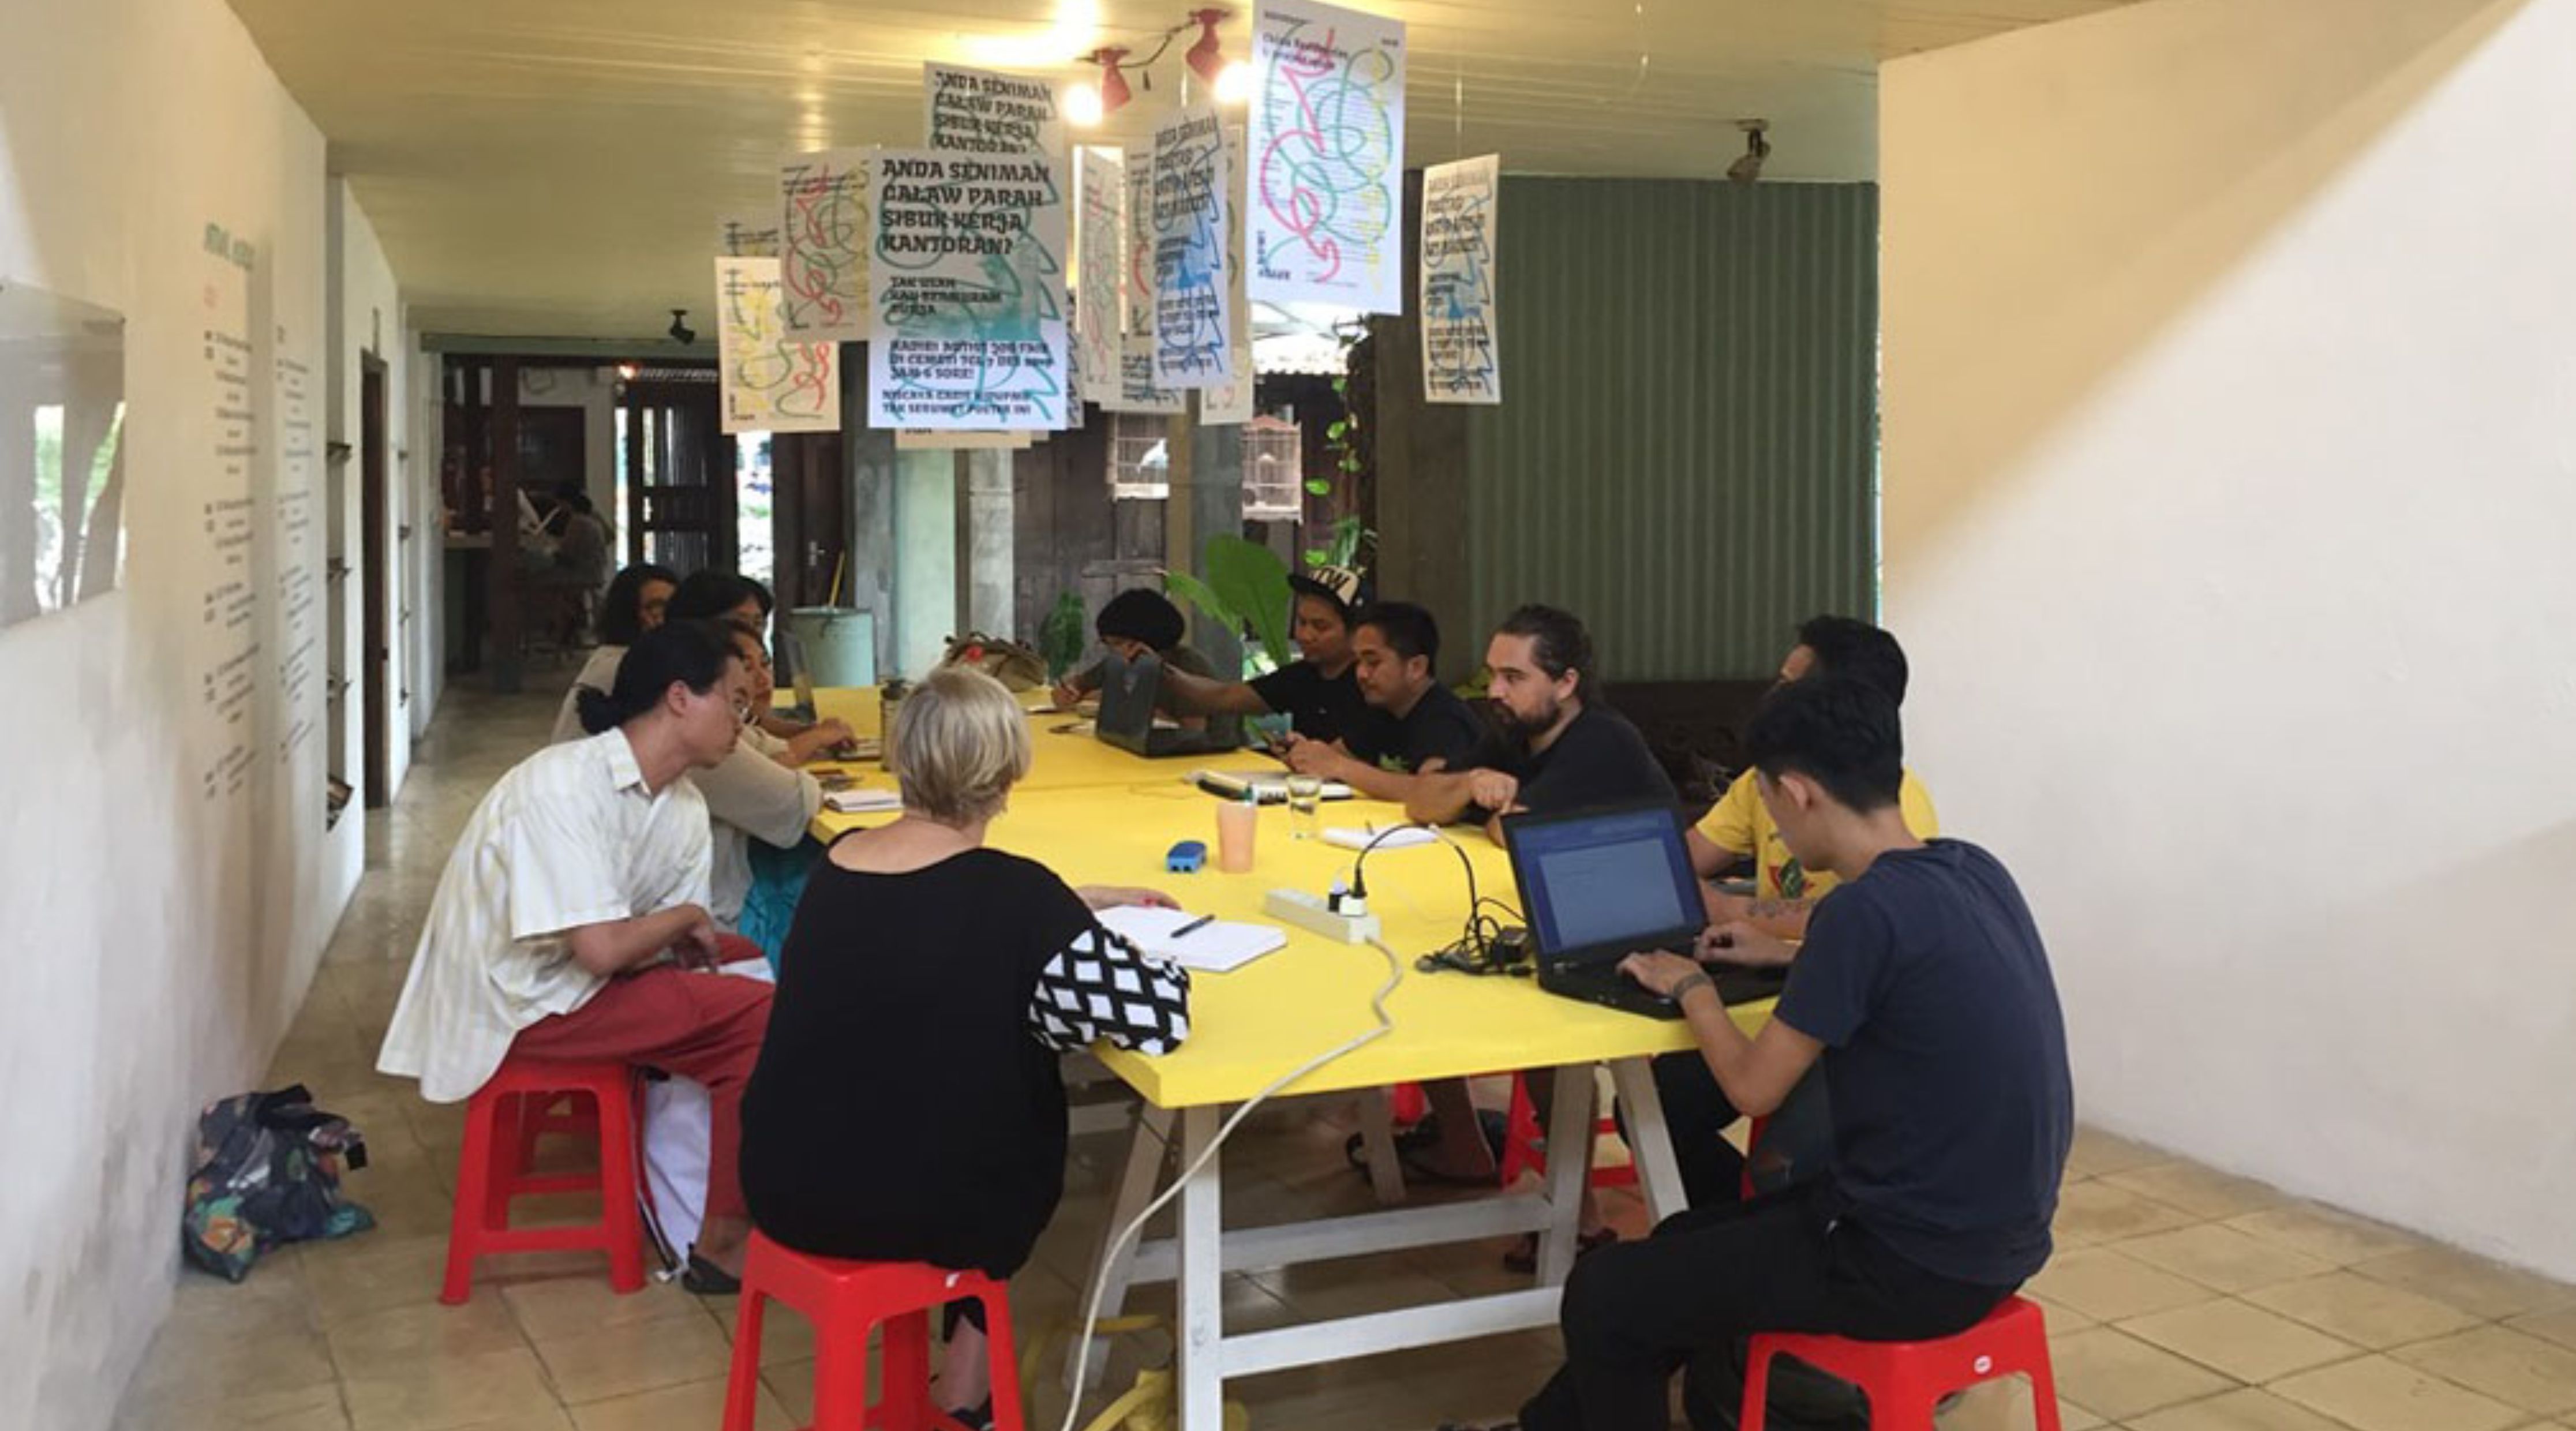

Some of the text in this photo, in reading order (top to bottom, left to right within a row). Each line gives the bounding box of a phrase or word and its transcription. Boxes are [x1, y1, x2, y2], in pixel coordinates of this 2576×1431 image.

[882, 159, 1049, 182] ANDA SENIMAN
[968, 188, 1042, 206] PARAH
[882, 210, 1022, 234] SIBUK KERJA
[884, 234, 1013, 254] KANTORAN?
